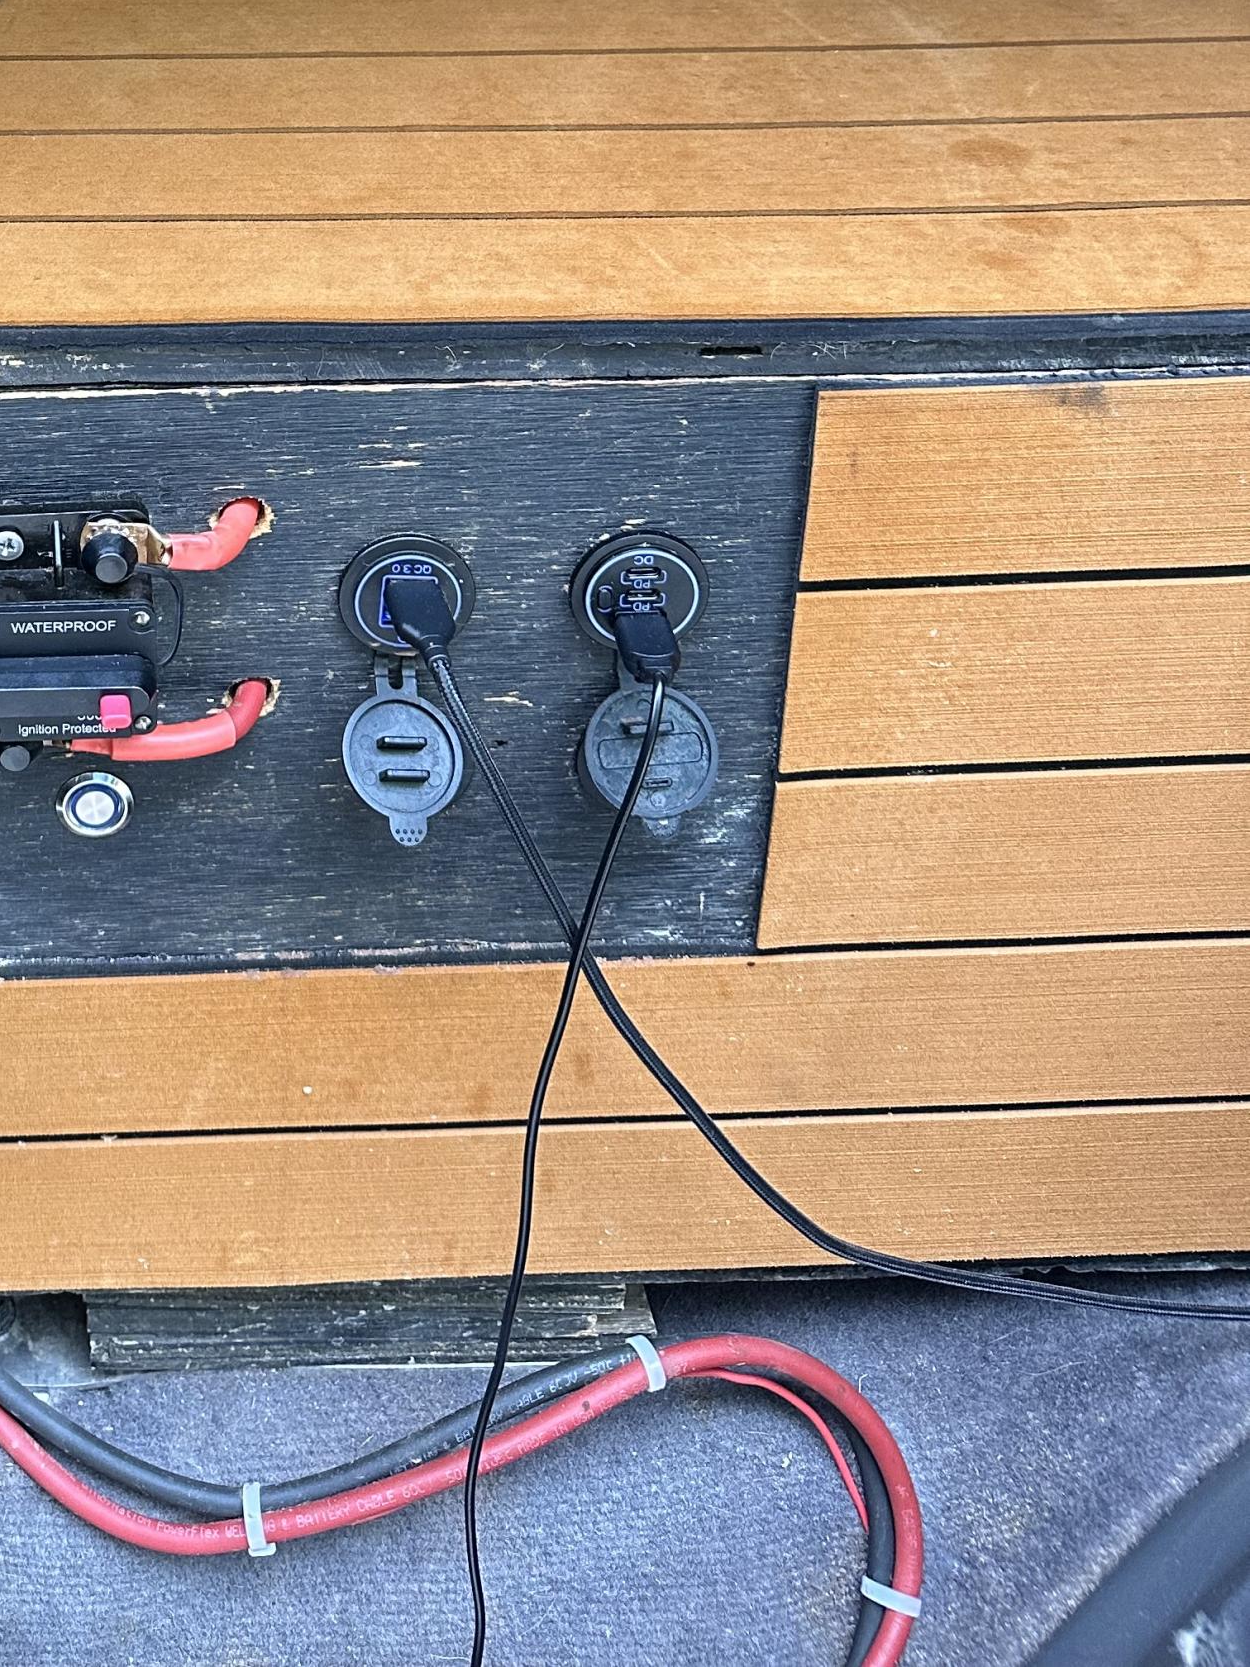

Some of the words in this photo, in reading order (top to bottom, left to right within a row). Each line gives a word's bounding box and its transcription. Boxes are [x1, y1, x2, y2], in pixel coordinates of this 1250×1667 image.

[633, 555, 654, 566] DC
[633, 579, 651, 589] PD
[632, 601, 650, 612] PD
[10, 620, 117, 634] WATERPROOF
[18, 724, 59, 737] Ignition
[355, 1487, 397, 1513] CABLE
